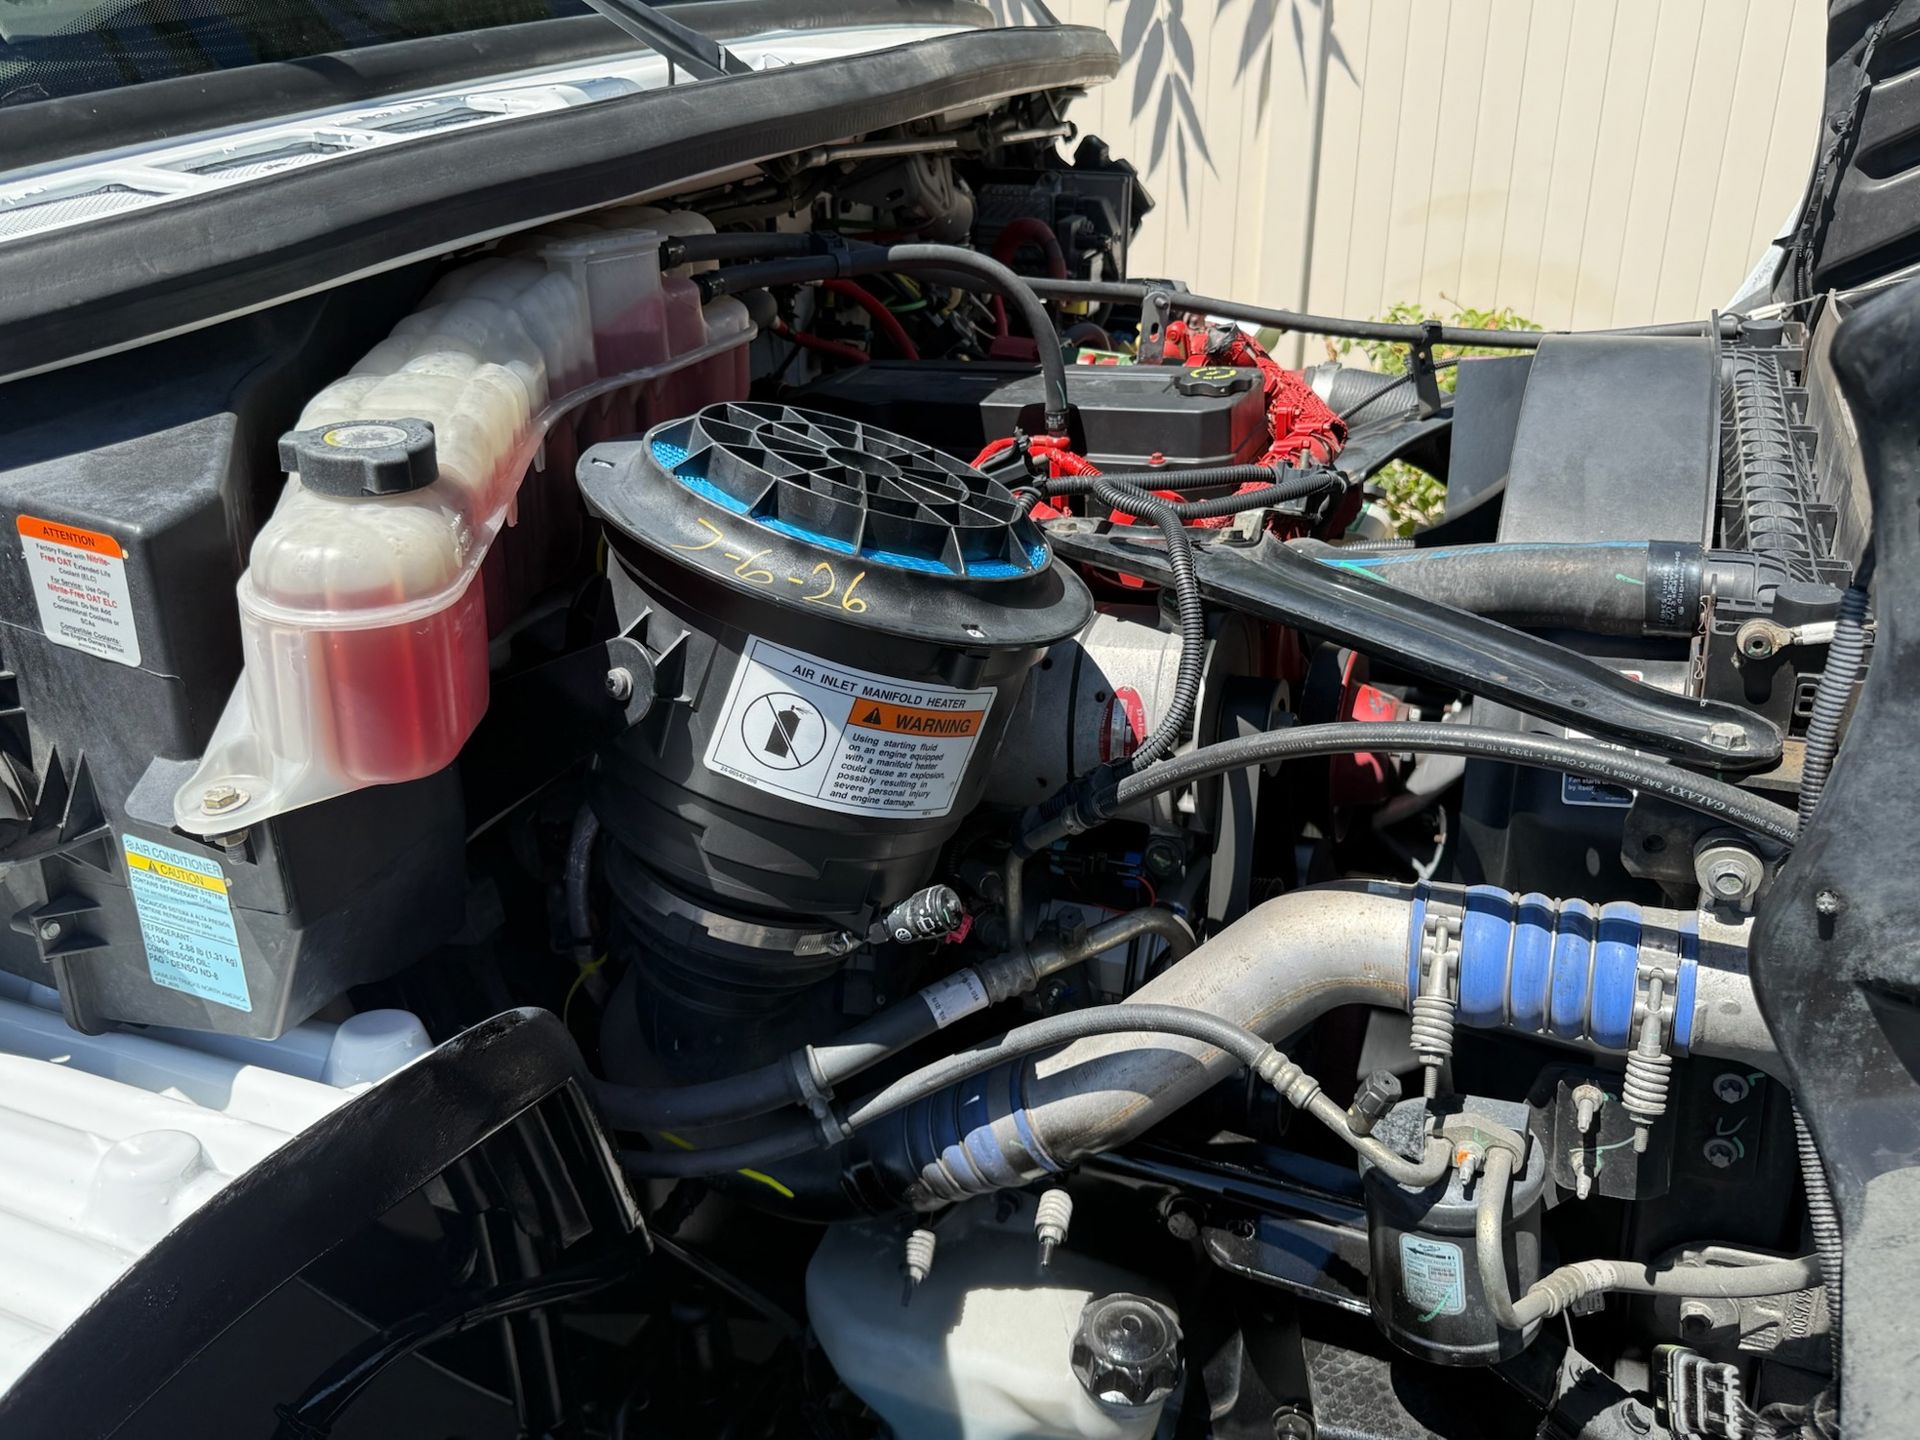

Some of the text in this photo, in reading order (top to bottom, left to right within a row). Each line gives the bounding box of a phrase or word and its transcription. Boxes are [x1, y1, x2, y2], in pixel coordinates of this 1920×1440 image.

[43, 527, 95, 546] ATTENTION
[40, 553, 56, 562] Free
[57, 557, 72, 567] OAT
[73, 562, 99, 574] Extended
[58, 568, 97, 583] Coolant (ELC)
[87, 594, 102, 604] OAT
[103, 598, 118, 609] ELC
[97, 588, 110, 598] Only
[53, 602, 88, 617] Conventional
[60, 622, 92, 636] Compatible
[80, 618, 96, 627] SCAs
[792, 665, 966, 709] AIR INLET MANIFOLD HEATER
[896, 714, 972, 734] WARNING
[852, 733, 938, 752] Using starting fluid
[849, 744, 861, 752] on
[878, 747, 907, 761] engine
[910, 753, 944, 761] equipped
[1550, 755, 1578, 767] Class
[841, 762, 866, 773] could
[870, 767, 895, 777] cause
[845, 753, 863, 762] with
[876, 758, 913, 769] manifold
[915, 762, 938, 770] heater
[1578, 761, 1587, 769] C
[1588, 762, 1611, 776] Type
[836, 771, 877, 785] possibly
[880, 777, 917, 790] resulting
[1612, 769, 1641, 781] J2064
[1641, 777, 1662, 788] SAE
[829, 790, 916, 807] and engine damage.
[833, 782, 931, 800] severe personal injury
[1665, 783, 1726, 811] GALAXY
[1767, 823, 1796, 840] HOSE
[135, 841, 221, 876] AIR CONDITIONER
[161, 866, 204, 885] CAUTION
[160, 883, 198, 900] REFRIGERANT
[143, 923, 193, 943] REFRIGERANT:
[147, 944, 211, 969] COMPRESSOR OIL:
[196, 947, 204, 957] lb
[171, 960, 199, 975] DENSO
[201, 983, 221, 995] NORTH
